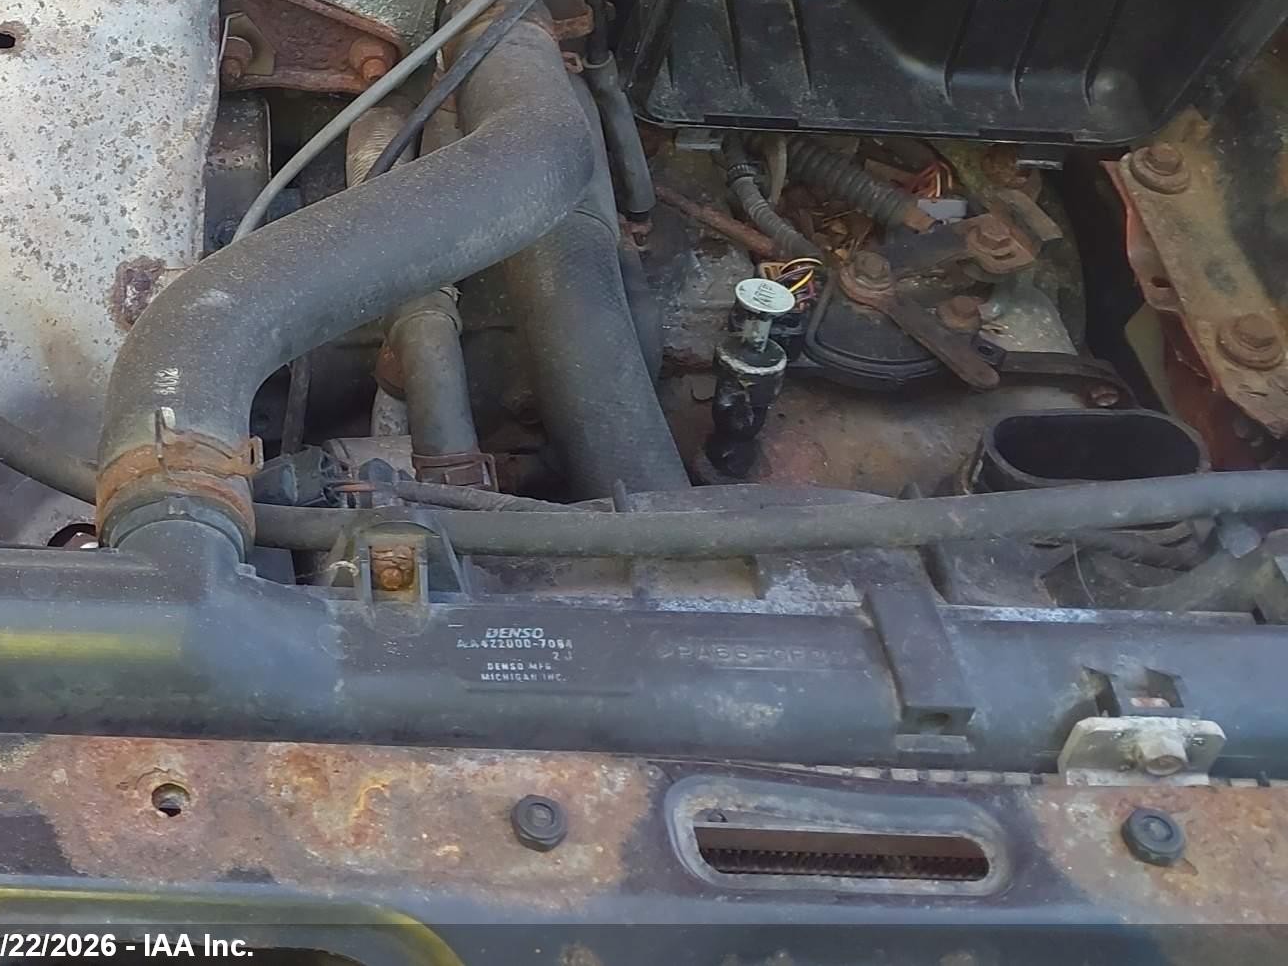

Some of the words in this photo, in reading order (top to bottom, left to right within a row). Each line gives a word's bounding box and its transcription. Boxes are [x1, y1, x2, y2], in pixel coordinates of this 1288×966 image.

[485, 627, 544, 639] DENSO
[487, 662, 524, 671] DENSO
[480, 673, 538, 682] MICHIGAN
